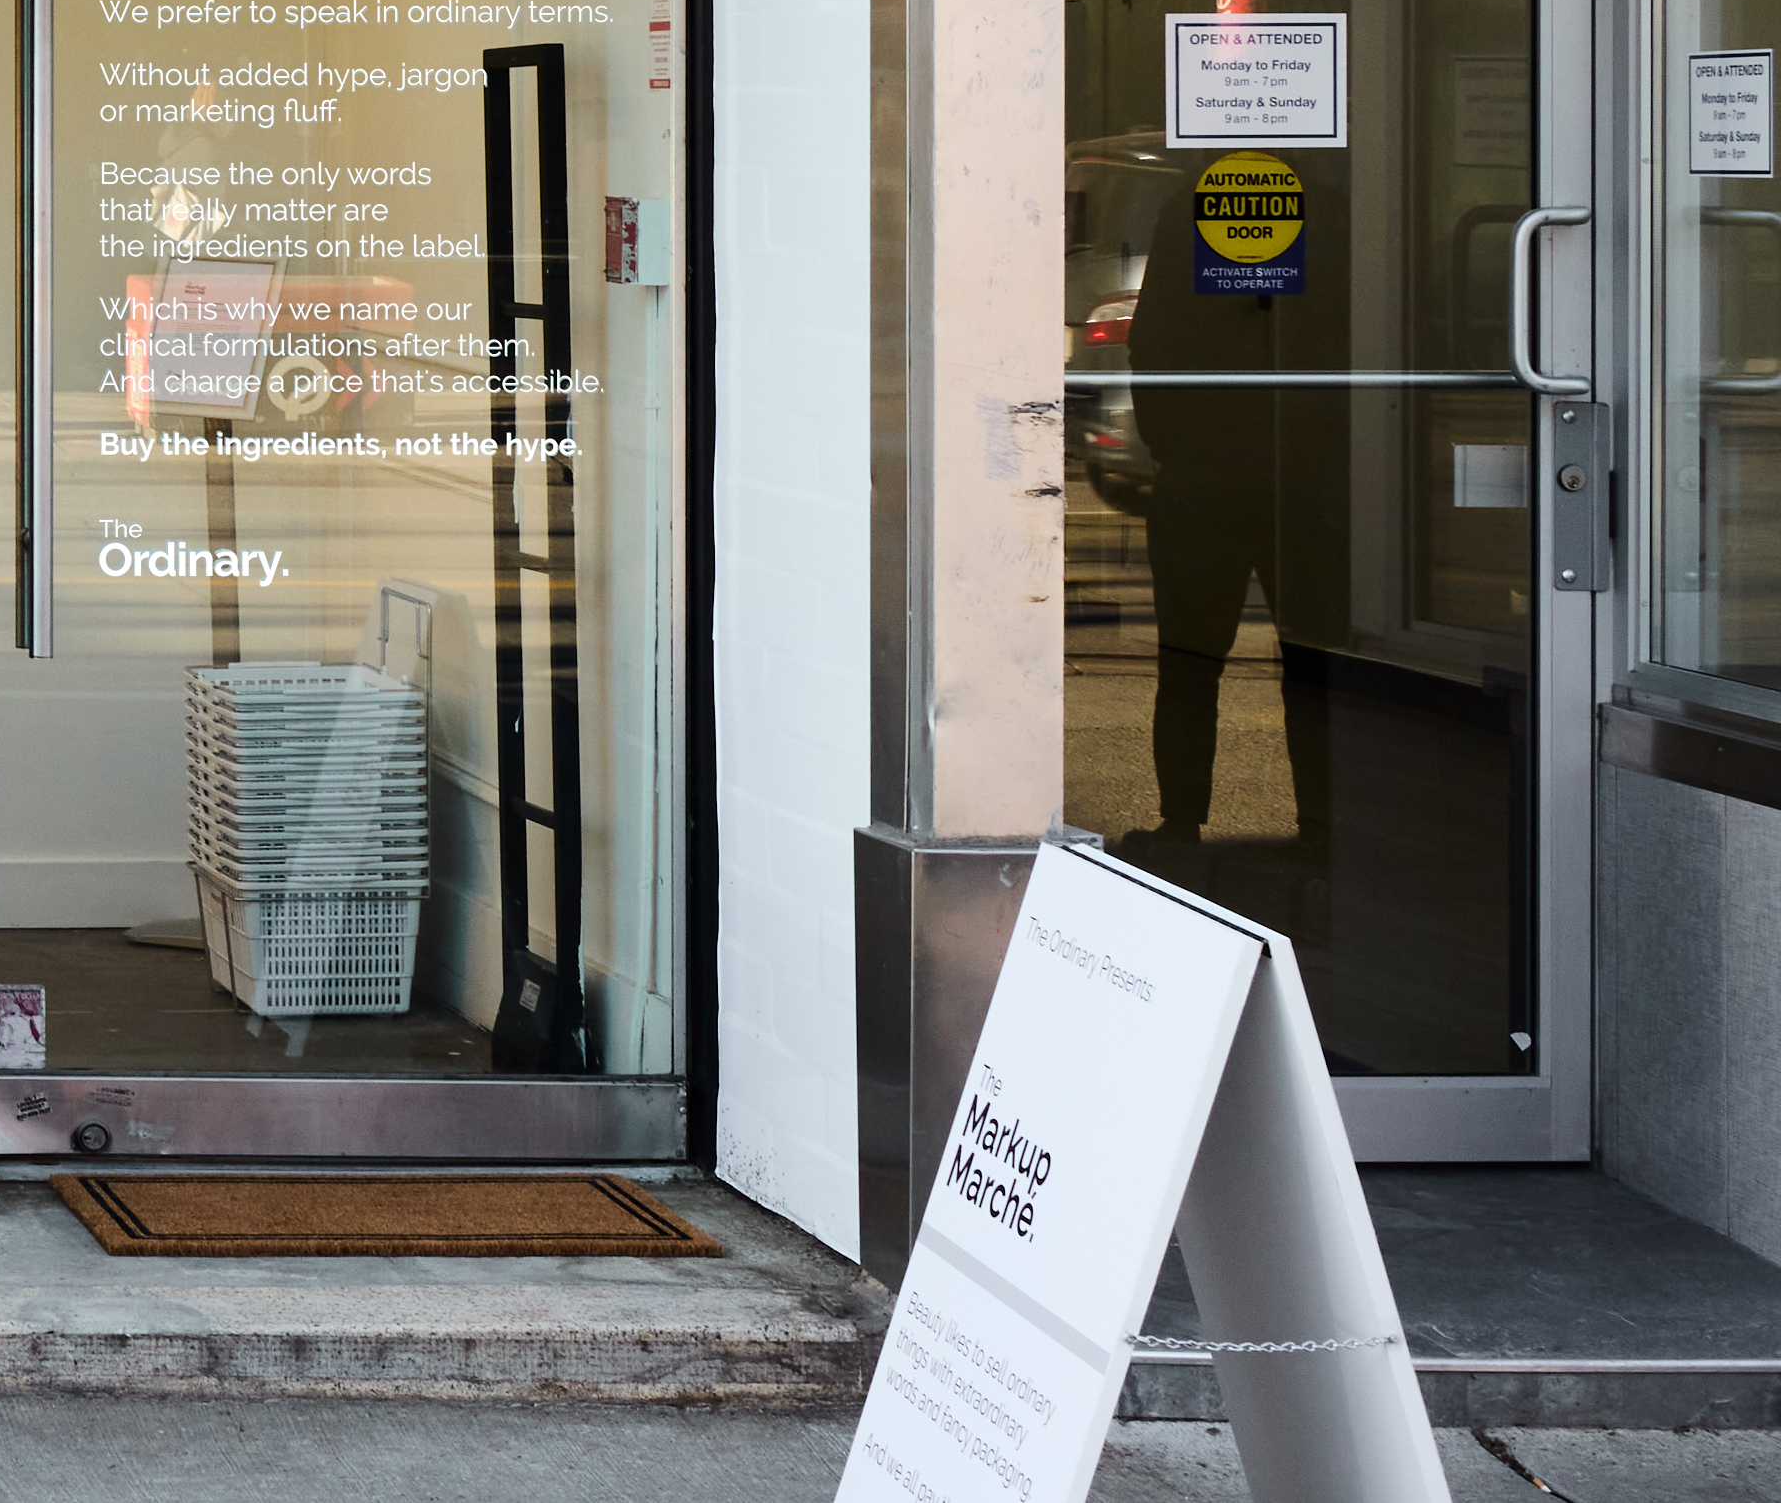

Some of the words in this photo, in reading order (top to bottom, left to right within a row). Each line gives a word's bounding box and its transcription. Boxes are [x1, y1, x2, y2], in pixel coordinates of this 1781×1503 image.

[99, 0, 149, 23] We
[158, 0, 242, 29] prefer
[249, 0, 276, 23] to
[285, 0, 368, 29] speak
[377, 0, 398, 23] in
[407, 0, 521, 29] ordinary
[528, 0, 613, 23] terms.
[1189, 33, 1229, 45] OPEN
[1233, 33, 1242, 45] &
[1246, 33, 1323, 45] ATTENDED
[99, 62, 211, 86] Without
[218, 62, 308, 86] added
[318, 62, 391, 92] hype,
[396, 62, 487, 92] jargon
[1201, 60, 1252, 73] Monday
[1255, 61, 1268, 71] to
[1272, 59, 1311, 73] Friday
[1696, 66, 1716, 78] OPEN
[1724, 64, 1764, 76] ATTENDED
[100, 104, 128, 122] or
[136, 98, 274, 129] marketing
[284, 98, 342, 122] fluff.
[1195, 97, 1253, 110] Saturday
[1256, 96, 1265, 108] &
[1269, 96, 1317, 110] Sunday
[101, 162, 221, 185] Because
[228, 161, 274, 185] the
[282, 161, 340, 192] only
[347, 161, 432, 185] words
[1204, 173, 1296, 186] AUTOMATIC
[1203, 196, 1298, 216] CAUTION
[1227, 226, 1273, 239] DOOR
[99, 233, 145, 258] the
[153, 233, 308, 264] ingredients
[316, 239, 350, 258] on
[359, 233, 404, 258] the
[413, 233, 485, 258] label.
[1202, 268, 1253, 277] ACTIVATE
[1255, 267, 1298, 277] SWITCH
[1217, 279, 1231, 289] TO
[1234, 279, 1284, 289] OPERATE
[100, 332, 196, 357] clinical
[202, 332, 377, 357] formulations
[385, 332, 451, 357] after
[457, 333, 535, 357] them.
[99, 369, 155, 393] And
[164, 369, 261, 399] charge
[269, 375, 285, 393] a
[294, 369, 363, 399] price
[371, 369, 444, 393] that's
[452, 369, 604, 393] accessible.
[101, 432, 155, 462] Buy
[161, 432, 210, 456] the
[217, 432, 387, 462] ingredients,
[396, 433, 443, 456] not
[450, 432, 498, 456] the
[506, 432, 583, 462] hype.
[98, 519, 143, 538] The
[98, 541, 289, 587] Ordinary.
[1026, 916, 1048, 946] The
[1049, 930, 1099, 979] Ordinary
[1099, 954, 1156, 1003] Presents:
[980, 1064, 1002, 1097] The
[962, 1094, 1051, 1195] Markup
[946, 1144, 1037, 1242] Marché.
[907, 1291, 946, 1341] Beauty
[945, 1318, 972, 1357] likes
[971, 1340, 985, 1367] to
[984, 1358, 1008, 1385] sell
[1006, 1372, 1057, 1426] ordinary
[896, 1327, 930, 1370] things
[929, 1358, 953, 1388] with
[953, 1375, 1029, 1451] extraordinary
[886, 1365, 920, 1405] words
[918, 1393, 943, 1422] and
[939, 1405, 972, 1453] fancy
[970, 1438, 1033, 1503] packaging.
